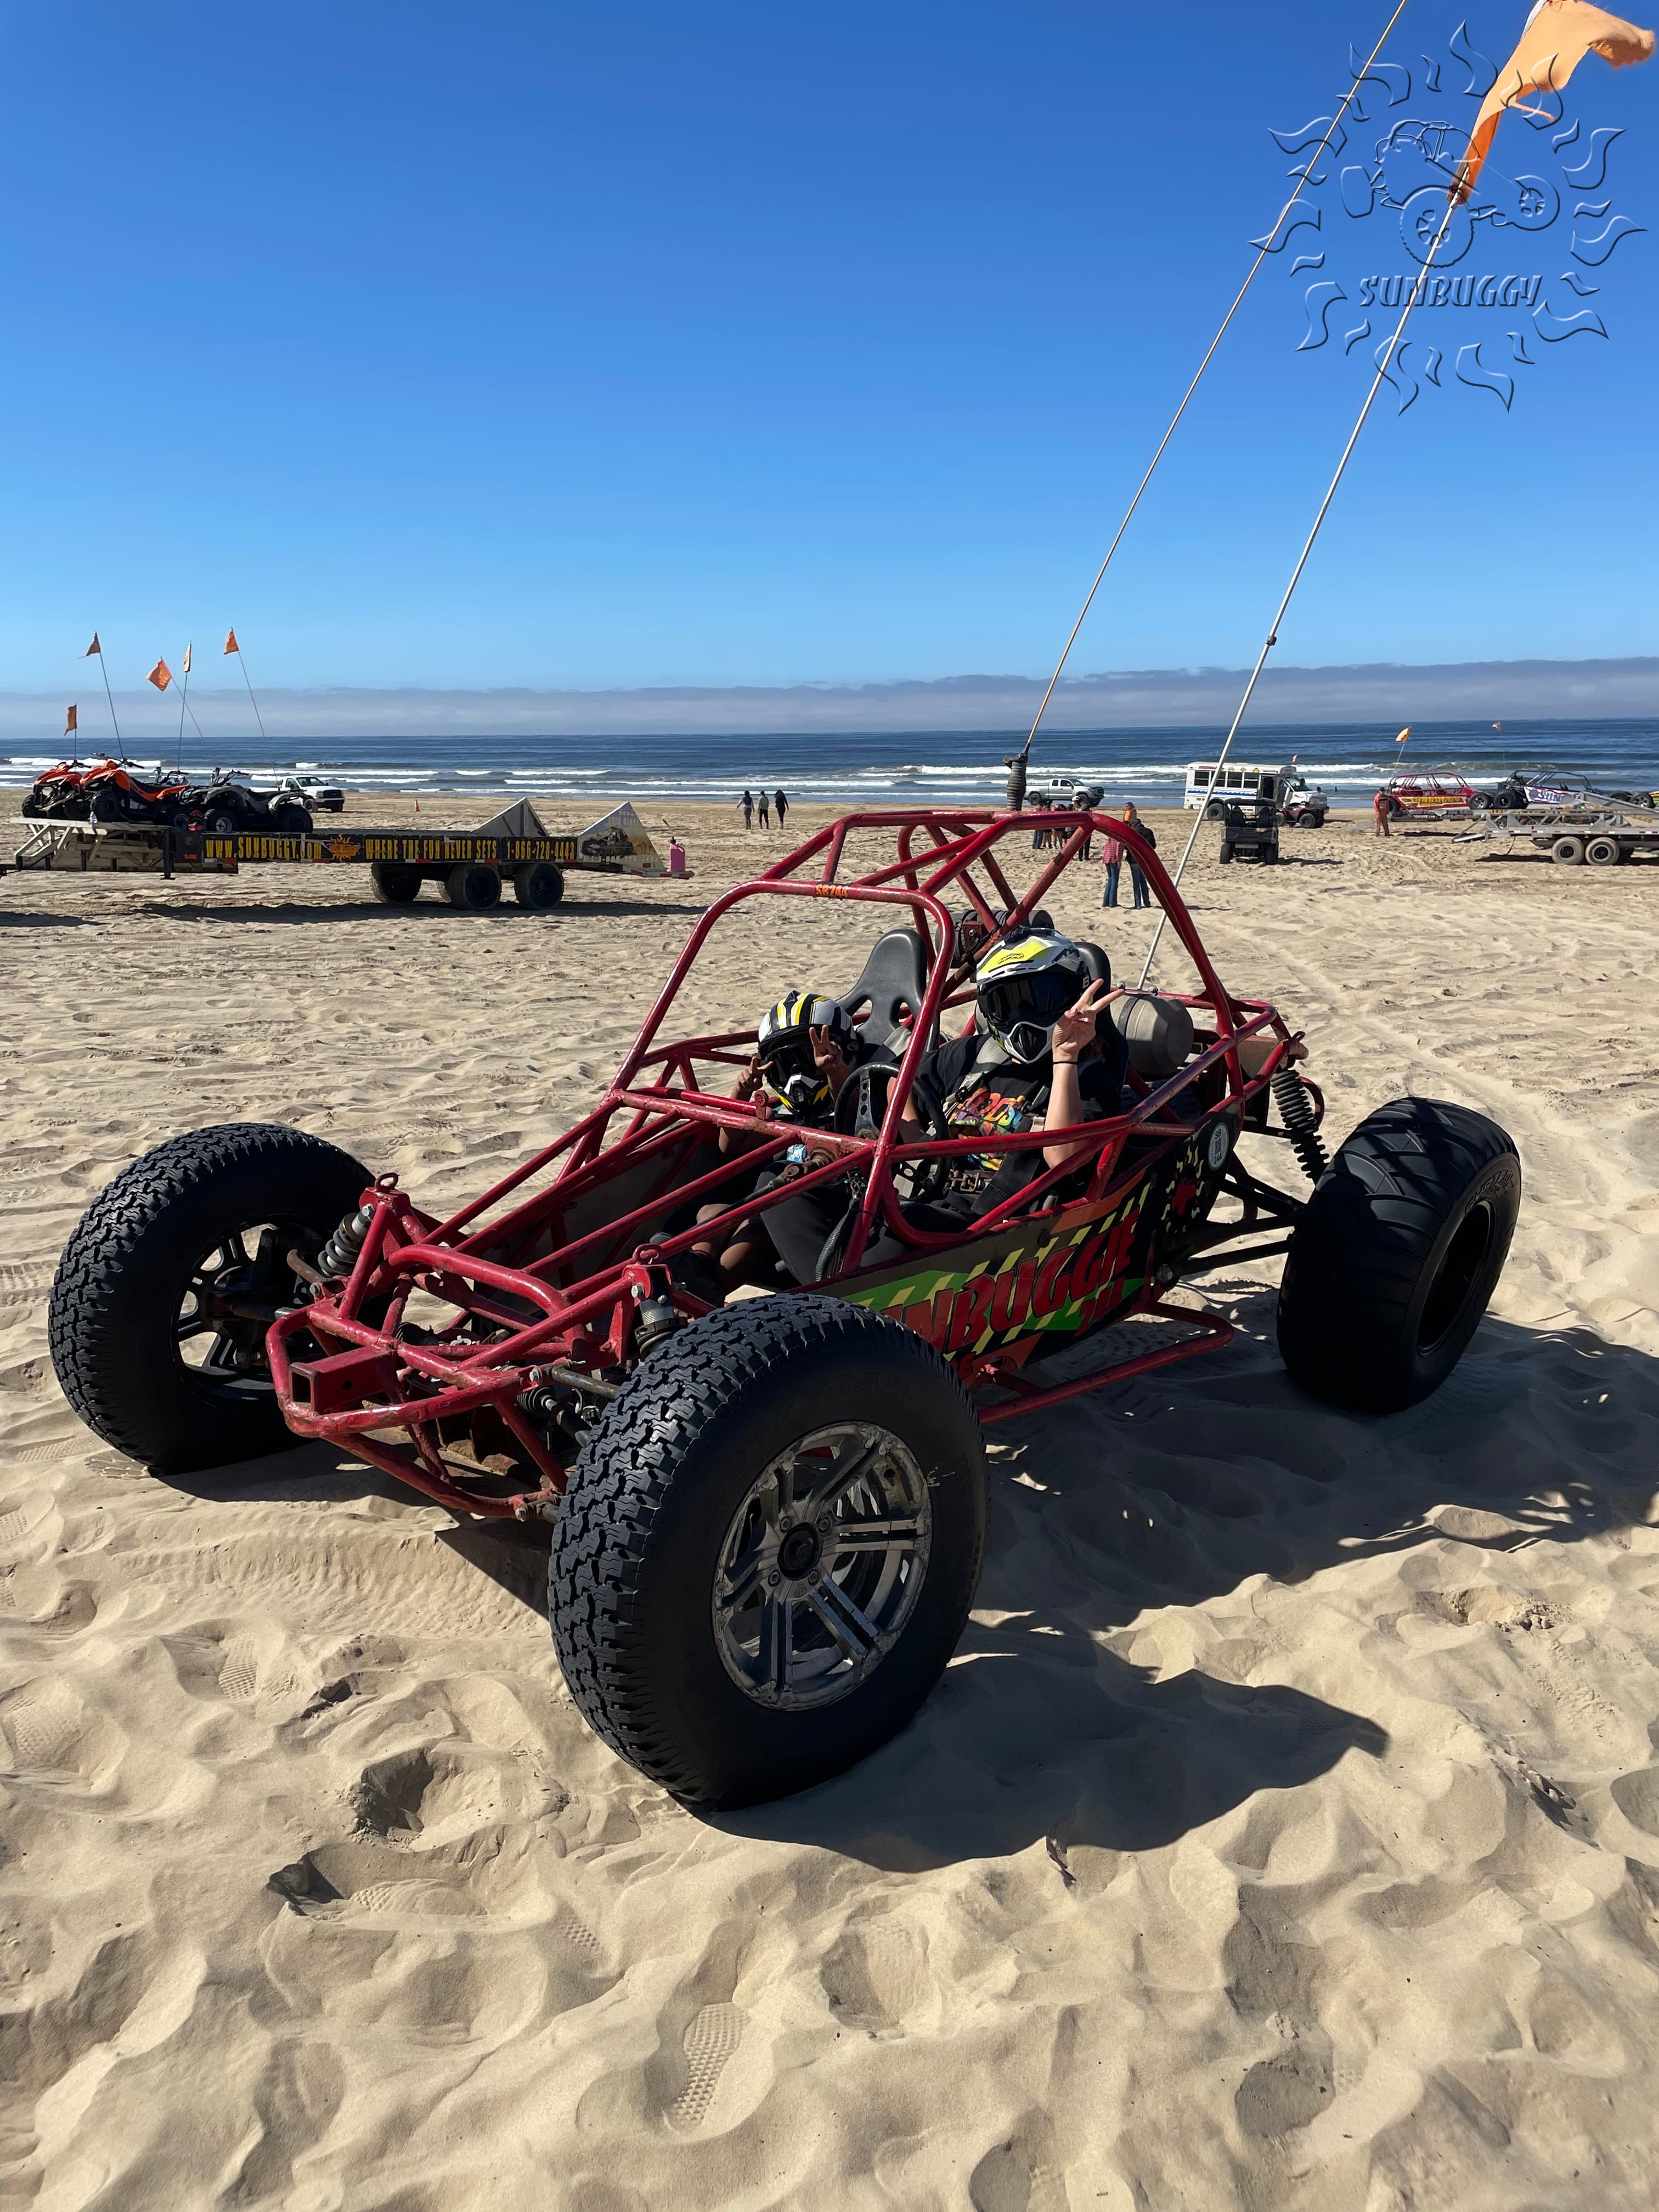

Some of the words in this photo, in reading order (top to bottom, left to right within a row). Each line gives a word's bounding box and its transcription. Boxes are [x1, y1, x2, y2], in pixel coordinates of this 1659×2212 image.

[365, 839, 398, 860] WHERE
[402, 839, 419, 860] THE
[424, 839, 439, 860] FUN
[444, 839, 472, 860] NEVER
[476, 839, 498, 860] SETS
[507, 841, 575, 860] 1-866-728-4443
[816, 884, 848, 897] SB244
[1215, 1128, 1222, 1139] SB
[1214, 1153, 1222, 1165] 244
[879, 1205, 1140, 1353] NBUGGIE
